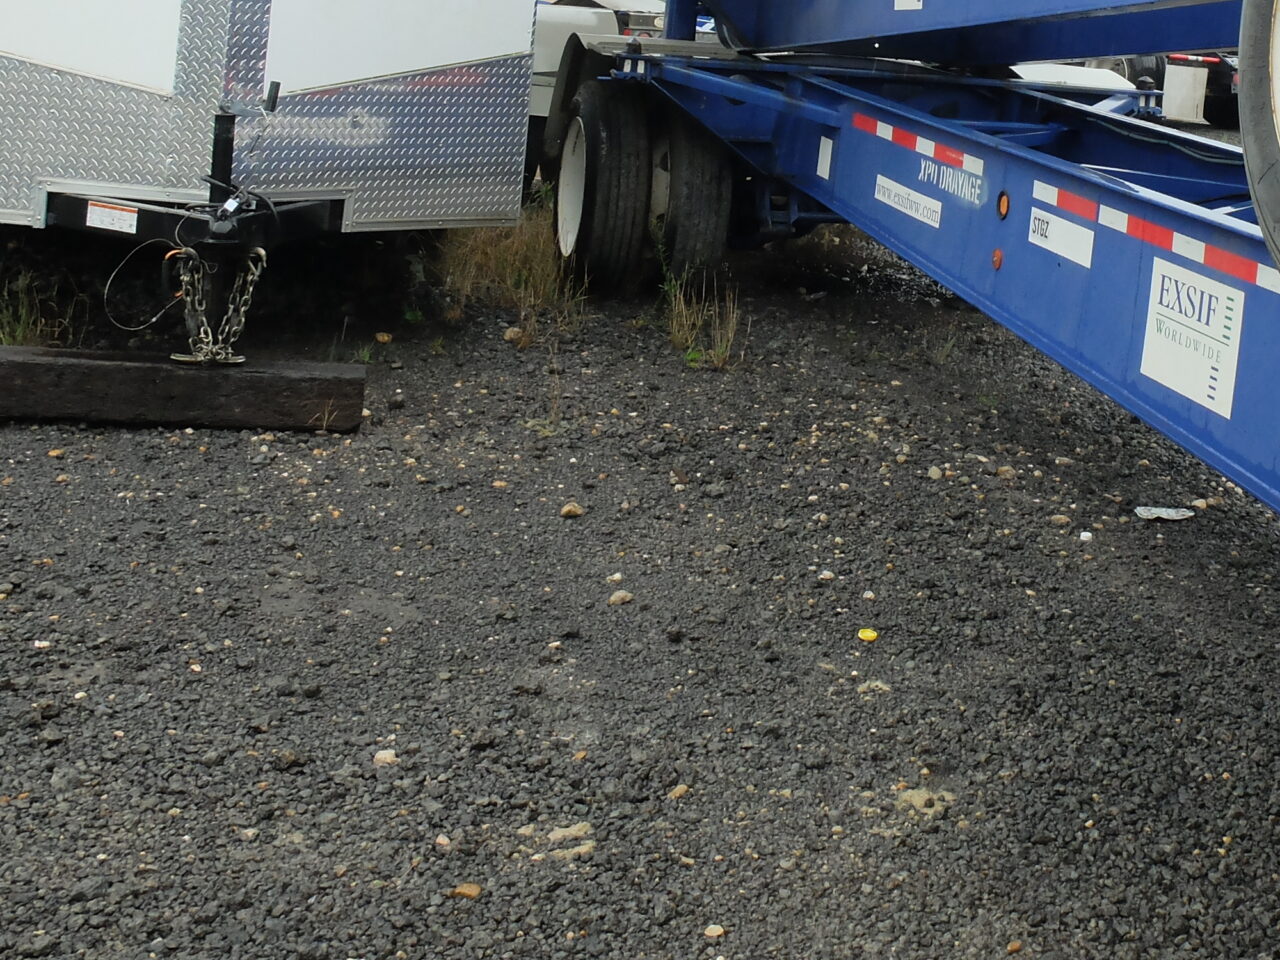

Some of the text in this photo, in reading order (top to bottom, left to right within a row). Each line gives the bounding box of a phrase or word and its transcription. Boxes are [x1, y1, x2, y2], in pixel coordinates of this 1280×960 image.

[876, 183, 940, 224] www.exsifww.com
[938, 166, 982, 205] DRAYAGE
[1032, 216, 1050, 239] STGZ
[1158, 273, 1219, 328] EXSIF
[1155, 317, 1222, 364] WORLDWIDE
